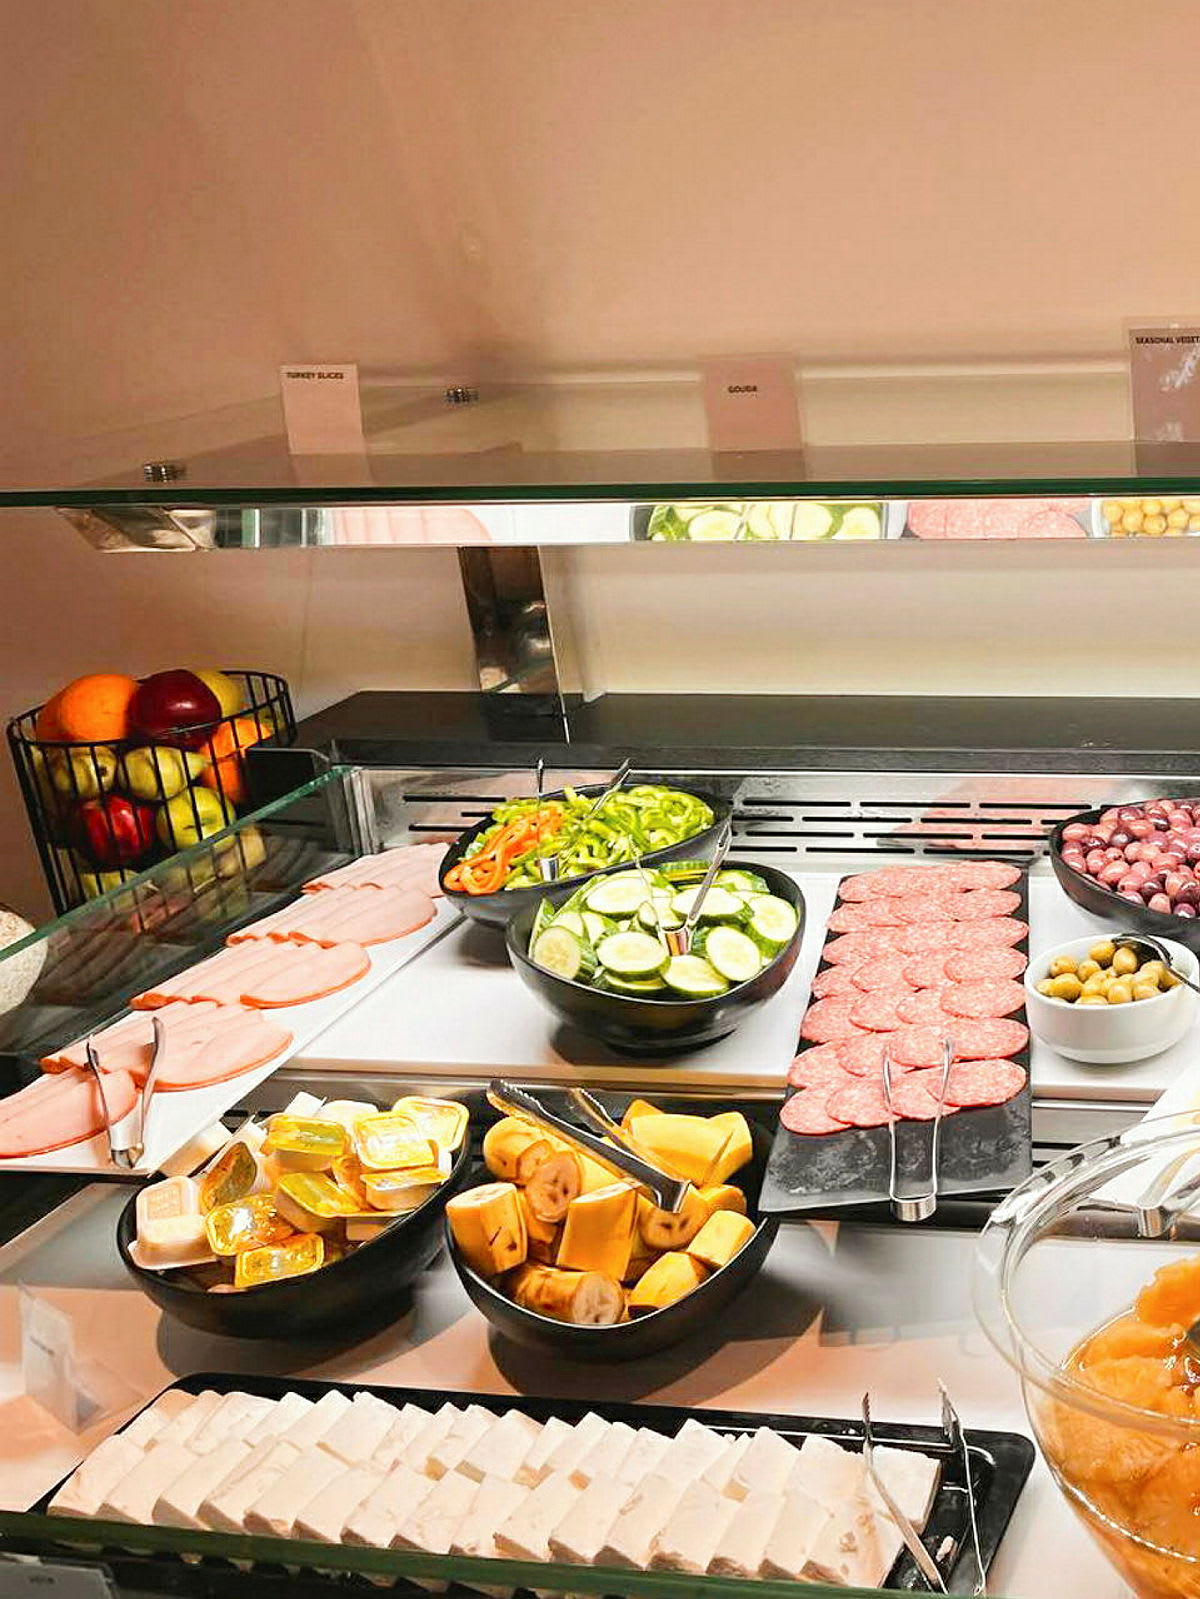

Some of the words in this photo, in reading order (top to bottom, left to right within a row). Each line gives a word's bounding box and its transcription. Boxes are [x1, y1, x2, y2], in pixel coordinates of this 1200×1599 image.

[1136, 336, 1174, 344] SEASONAL
[287, 371, 315, 379] TURKEY
[728, 385, 757, 393] GOUDA
